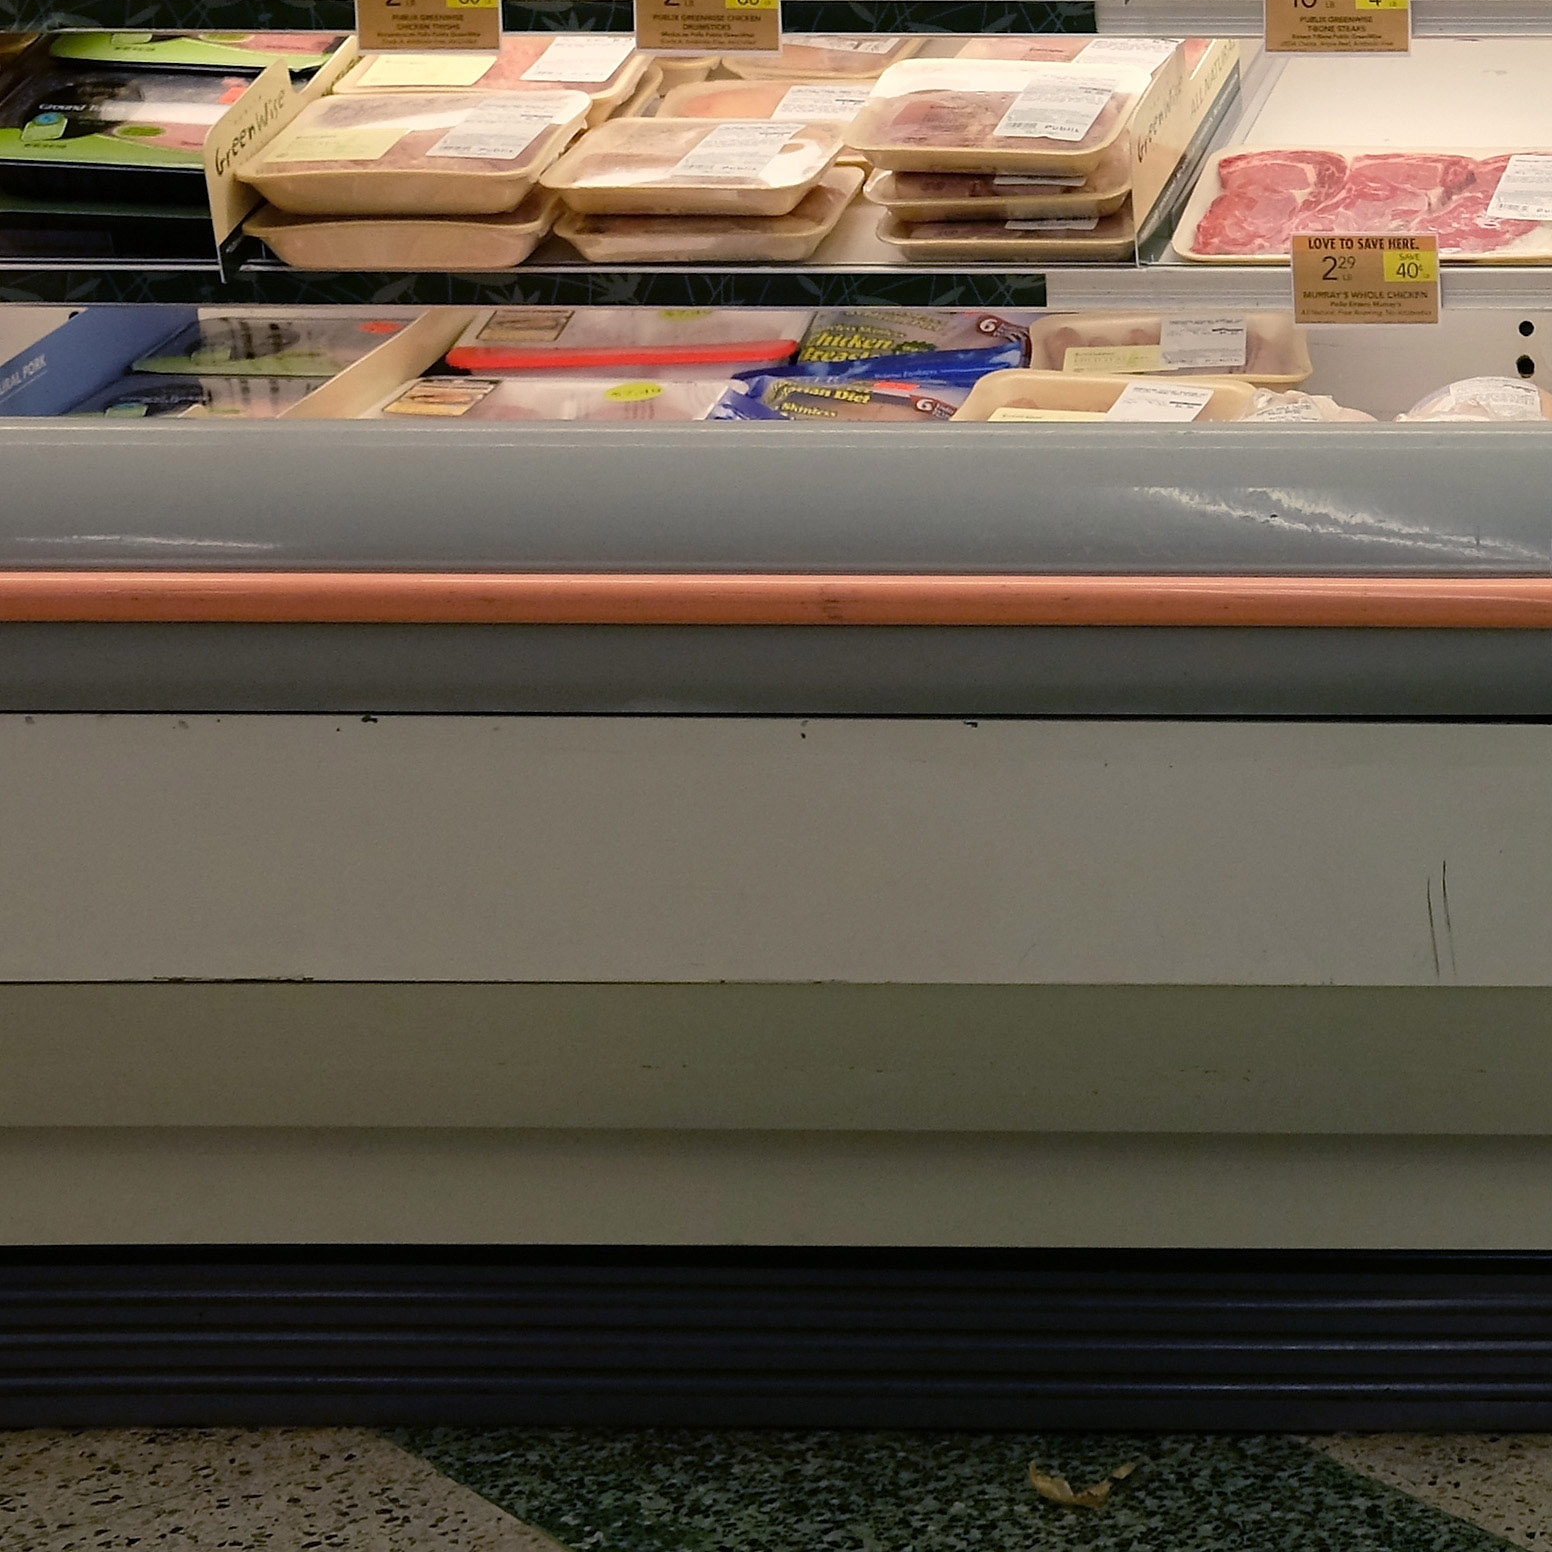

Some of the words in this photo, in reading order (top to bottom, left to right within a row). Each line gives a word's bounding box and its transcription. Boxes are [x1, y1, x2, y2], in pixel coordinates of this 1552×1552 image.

[39, 103, 87, 111] Ground
[215, 89, 285, 175] GreenWise
[1044, 125, 1080, 133] Publix
[1308, 238, 1335, 249] LOVE
[1340, 238, 1354, 249] TO
[1358, 238, 1384, 249] SAVE
[1388, 238, 1420, 249] HERE.
[809, 332, 894, 349] hicken
[833, 389, 871, 404] Diet
